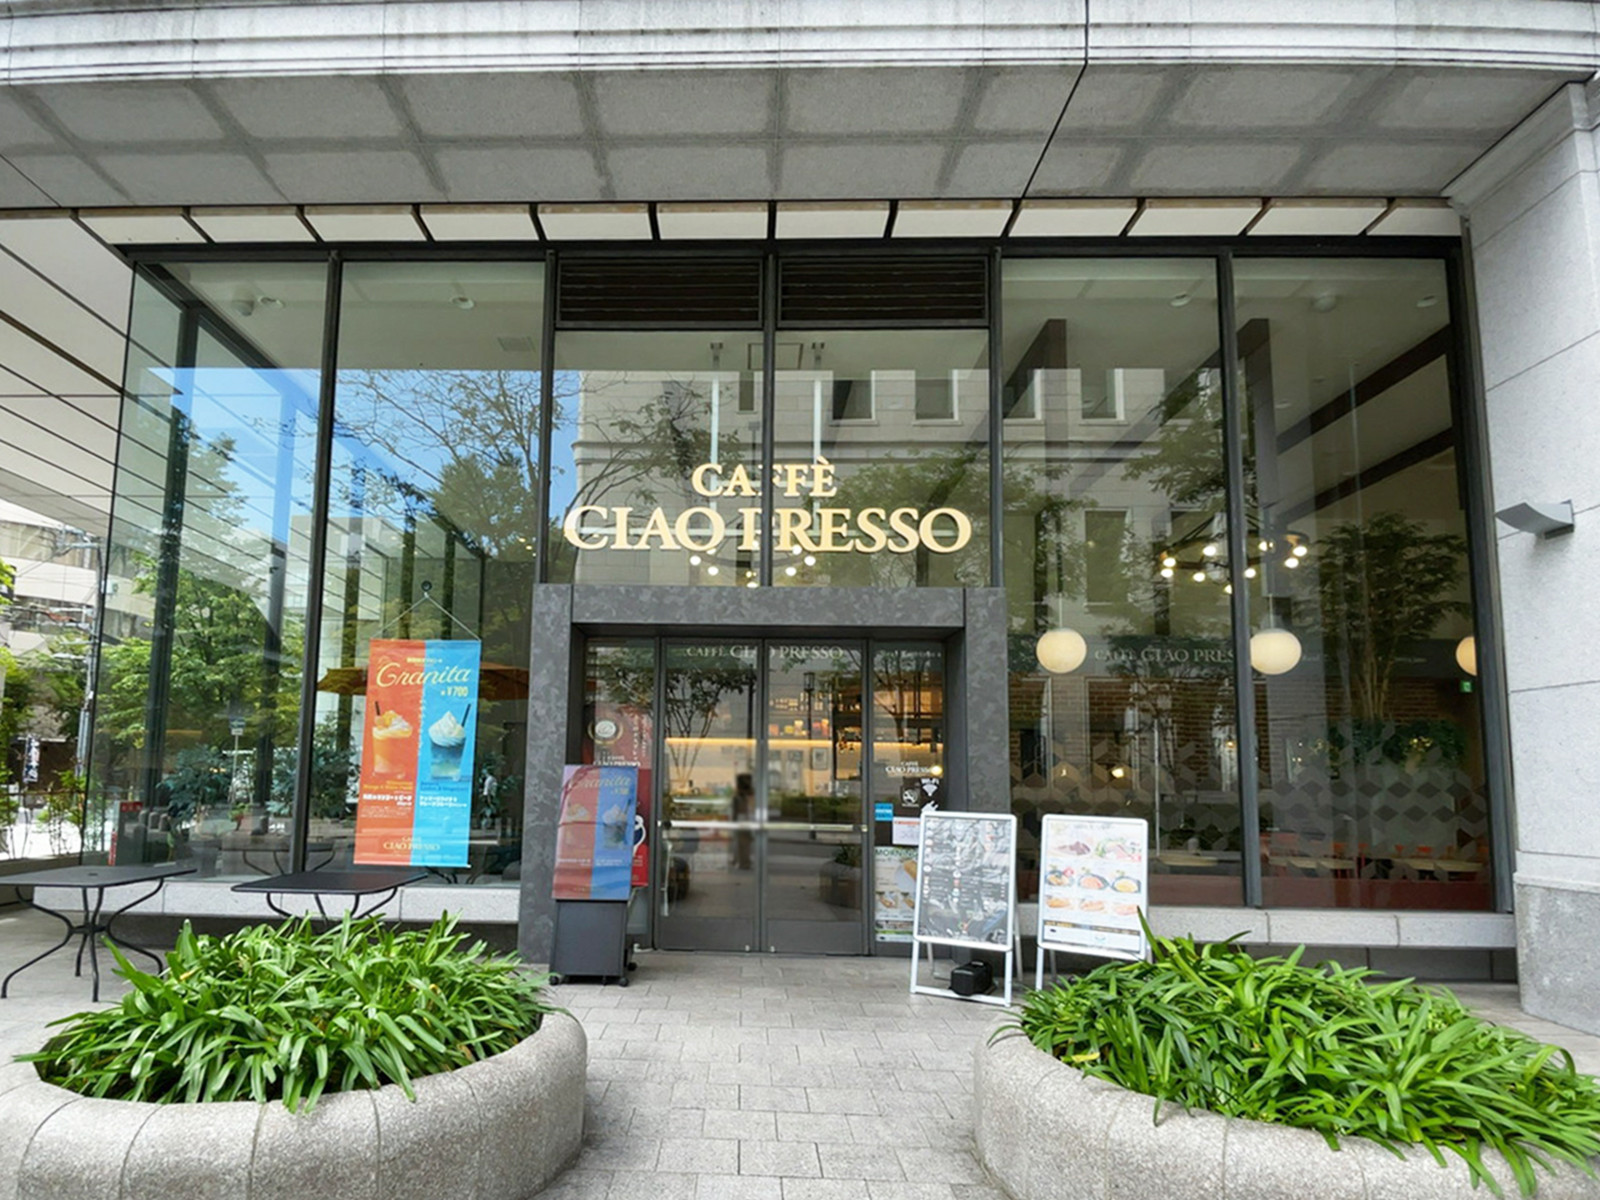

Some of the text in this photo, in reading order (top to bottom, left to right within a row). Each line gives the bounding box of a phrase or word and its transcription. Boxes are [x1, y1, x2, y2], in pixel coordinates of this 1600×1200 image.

[563, 505, 973, 553] CIAO PRESSO
[780, 645, 844, 659] PRESSO
[1141, 647, 1189, 662] CIAO
[376, 662, 472, 687] Granita
